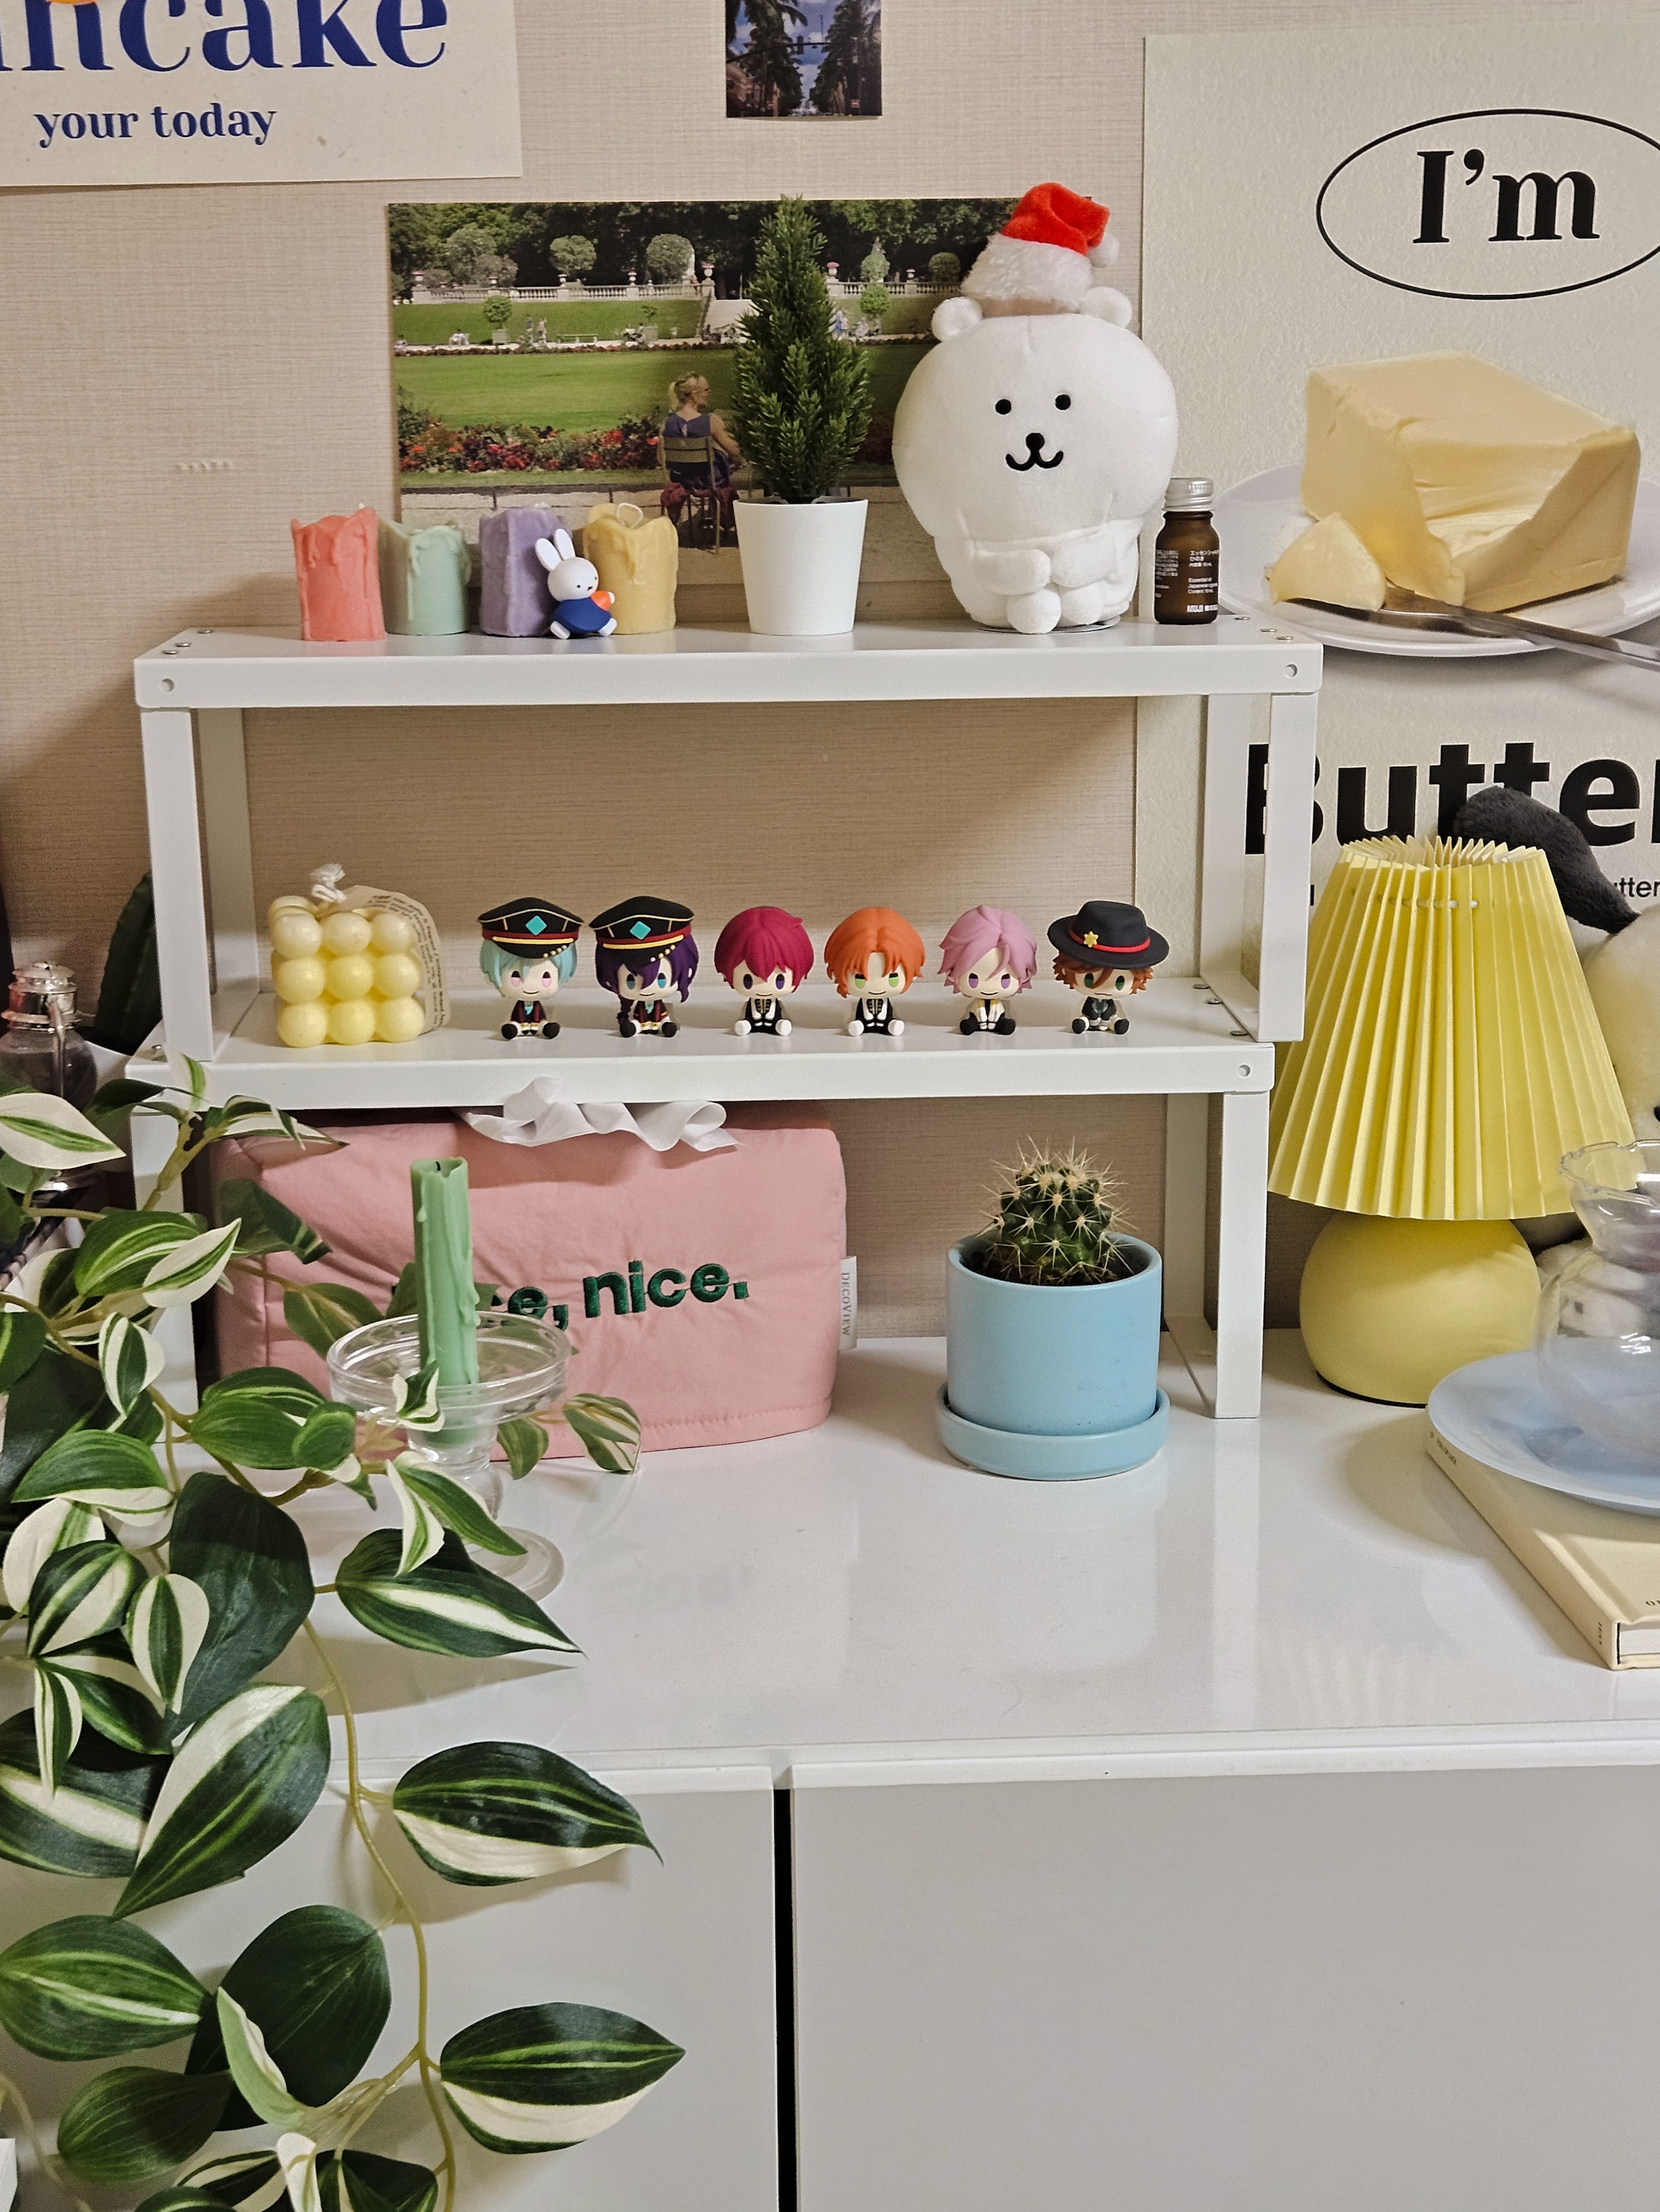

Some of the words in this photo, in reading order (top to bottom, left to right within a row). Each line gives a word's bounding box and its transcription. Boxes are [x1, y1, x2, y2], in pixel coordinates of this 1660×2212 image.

[34, 107, 139, 148] your
[152, 102, 276, 145] today
[1413, 148, 1600, 244] I’m
[583, 1260, 750, 1319] nice.
[842, 1272, 852, 1336] DECOVIEW
